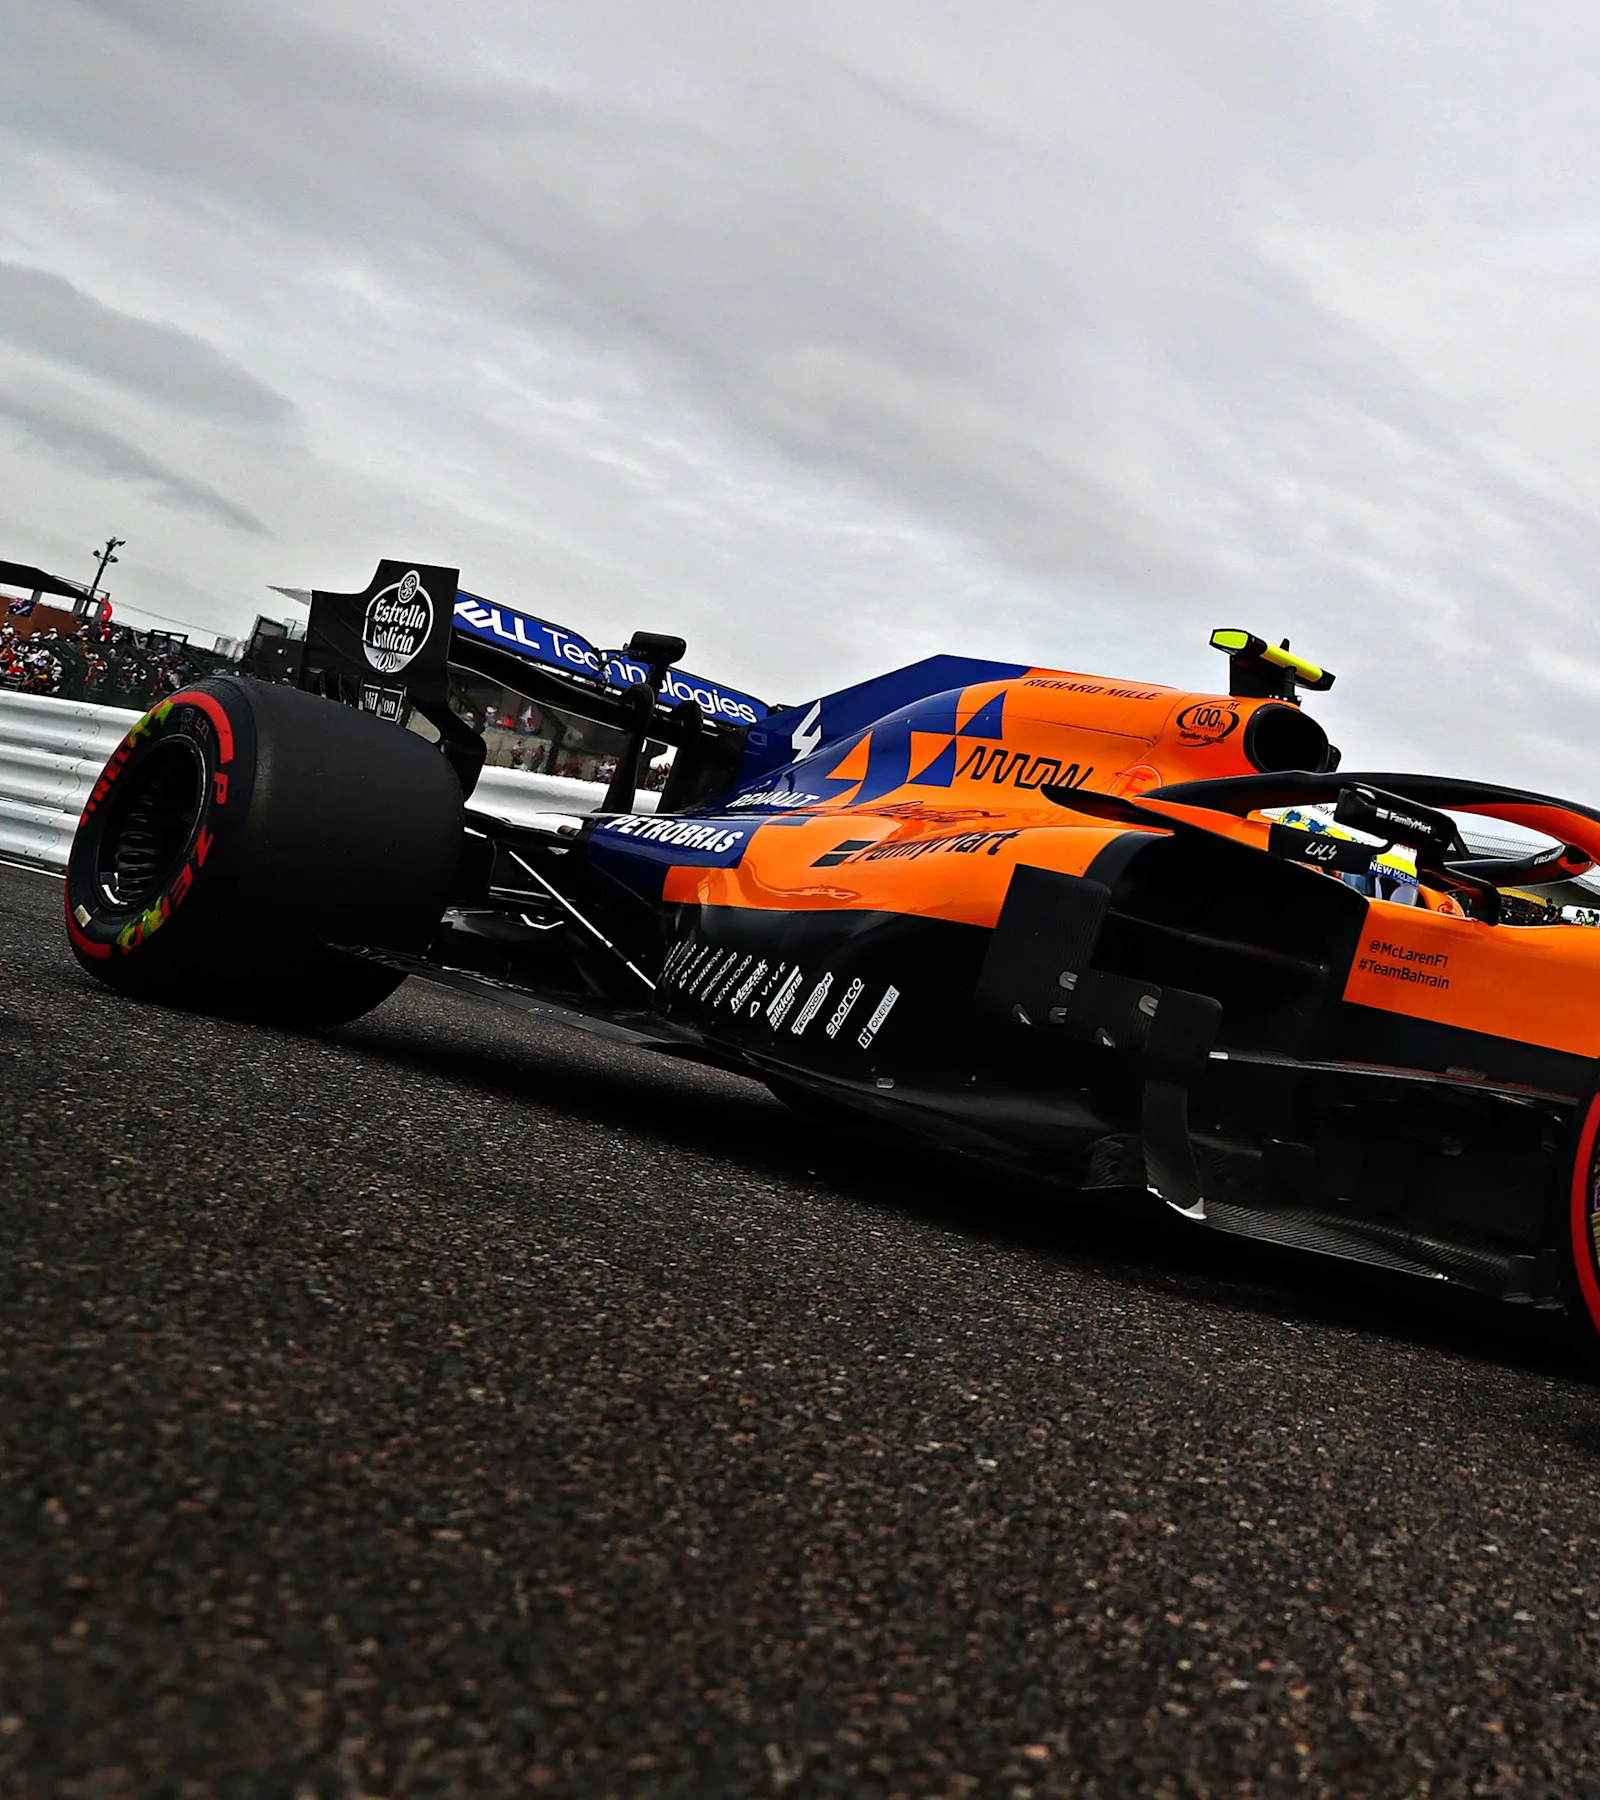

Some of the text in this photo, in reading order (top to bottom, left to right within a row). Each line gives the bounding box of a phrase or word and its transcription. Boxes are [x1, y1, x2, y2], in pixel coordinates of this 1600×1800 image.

[373, 598, 426, 629] Estrella
[372, 624, 415, 654] Galicia
[1023, 679, 1163, 701] RICHARD MILLE
[792, 700, 822, 763] 4
[213, 771, 229, 805] P
[725, 791, 820, 808] RENAULT
[603, 815, 744, 853] PETROBRAS
[1390, 811, 1432, 834] FamilyMart
[1369, 861, 1393, 876] NEW
[1369, 940, 1449, 969] @McLarenF1
[713, 955, 753, 1007] KENWOOD
[730, 958, 768, 1011] Mazak
[761, 962, 787, 996] VIVE
[1357, 958, 1451, 990] #TeamBahrain
[769, 973, 803, 1027] sikkens
[826, 977, 863, 1037] sparco
[870, 988, 897, 1029] ONEPLUS
